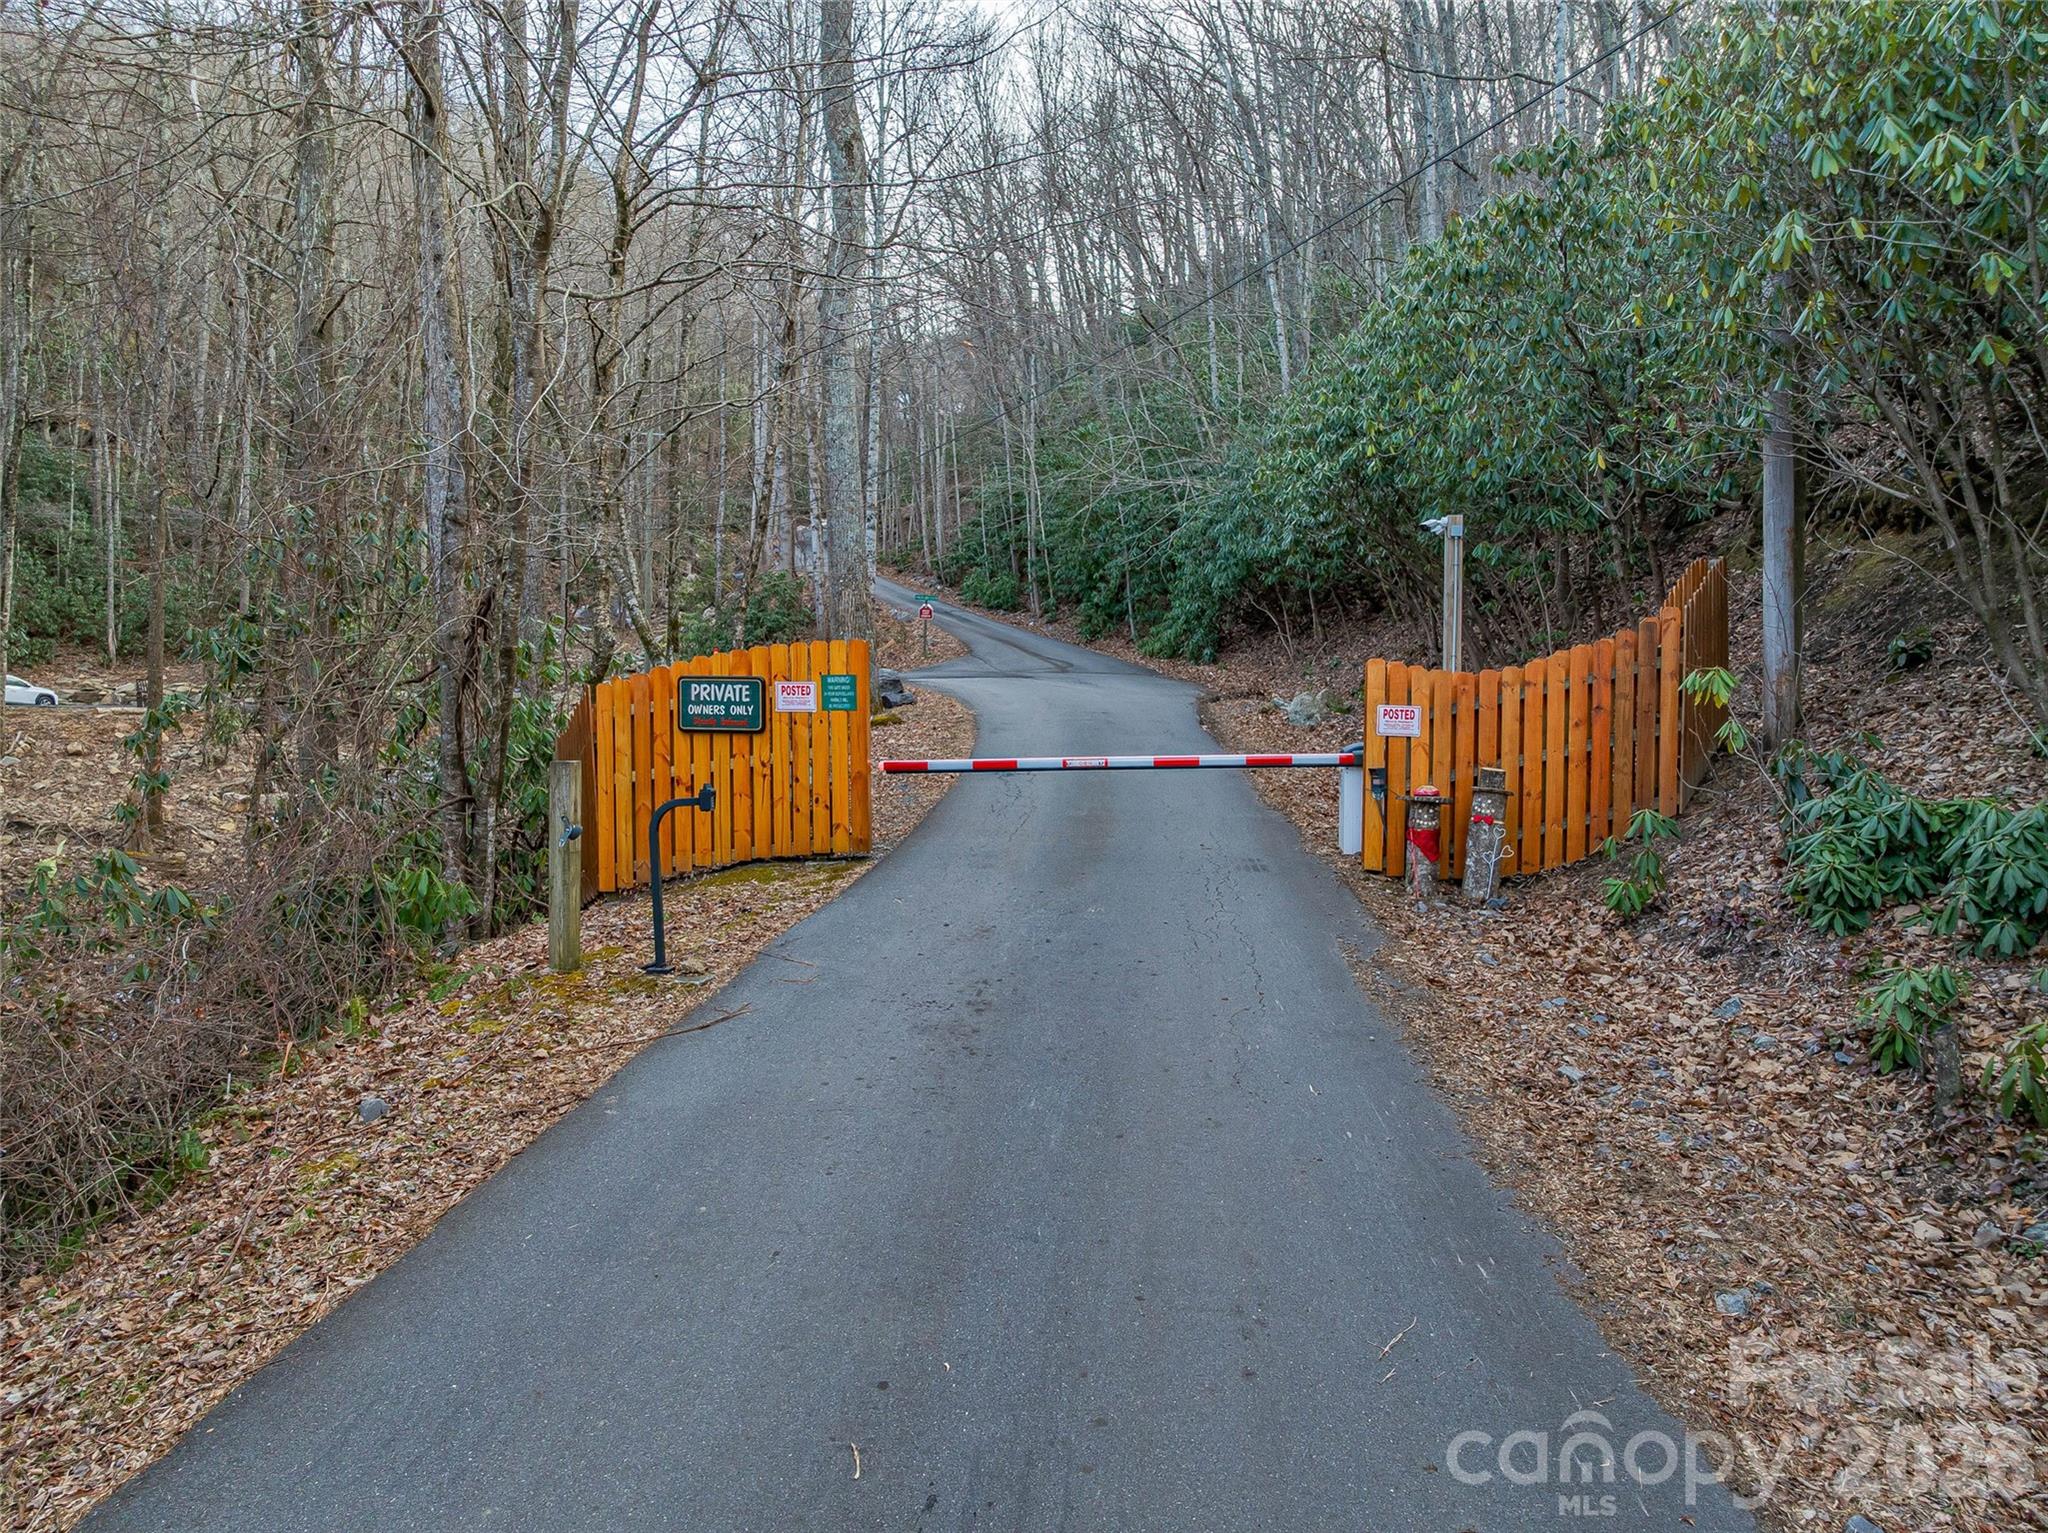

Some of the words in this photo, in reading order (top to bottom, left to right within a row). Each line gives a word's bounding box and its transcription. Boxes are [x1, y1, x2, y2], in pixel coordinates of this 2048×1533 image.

[690, 684, 750, 702] PRIVATE
[781, 685, 811, 696] POSTED
[687, 704, 725, 715] OWNERS
[730, 704, 754, 716] ONLY
[1383, 708, 1415, 720] POSTED
